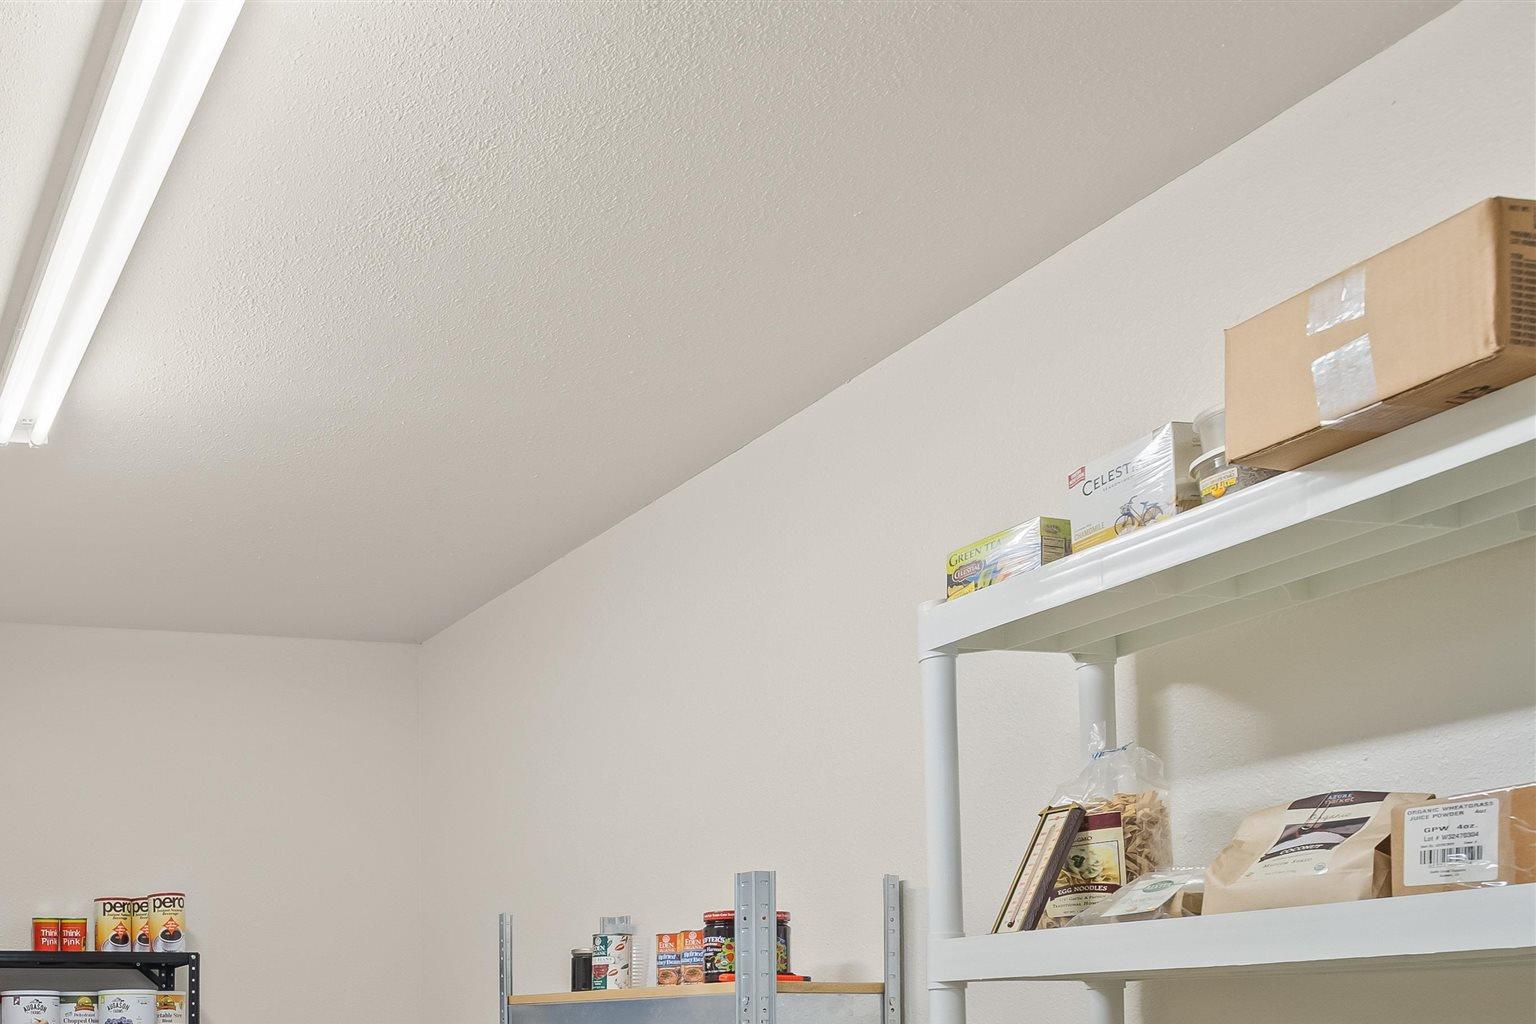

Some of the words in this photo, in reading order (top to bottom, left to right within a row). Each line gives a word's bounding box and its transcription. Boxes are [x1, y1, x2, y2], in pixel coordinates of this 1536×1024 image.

[949, 548, 981, 567] GREEN
[984, 538, 1002, 551] TEA
[1407, 807, 1439, 816] ORGANIC
[1442, 801, 1494, 811] WHEATGRASS
[1432, 811, 1464, 819] POWDER
[1424, 825, 1450, 833] GPW
[1057, 888, 1072, 896] EGG
[1073, 885, 1108, 893] NOODLES
[153, 897, 184, 913] pero
